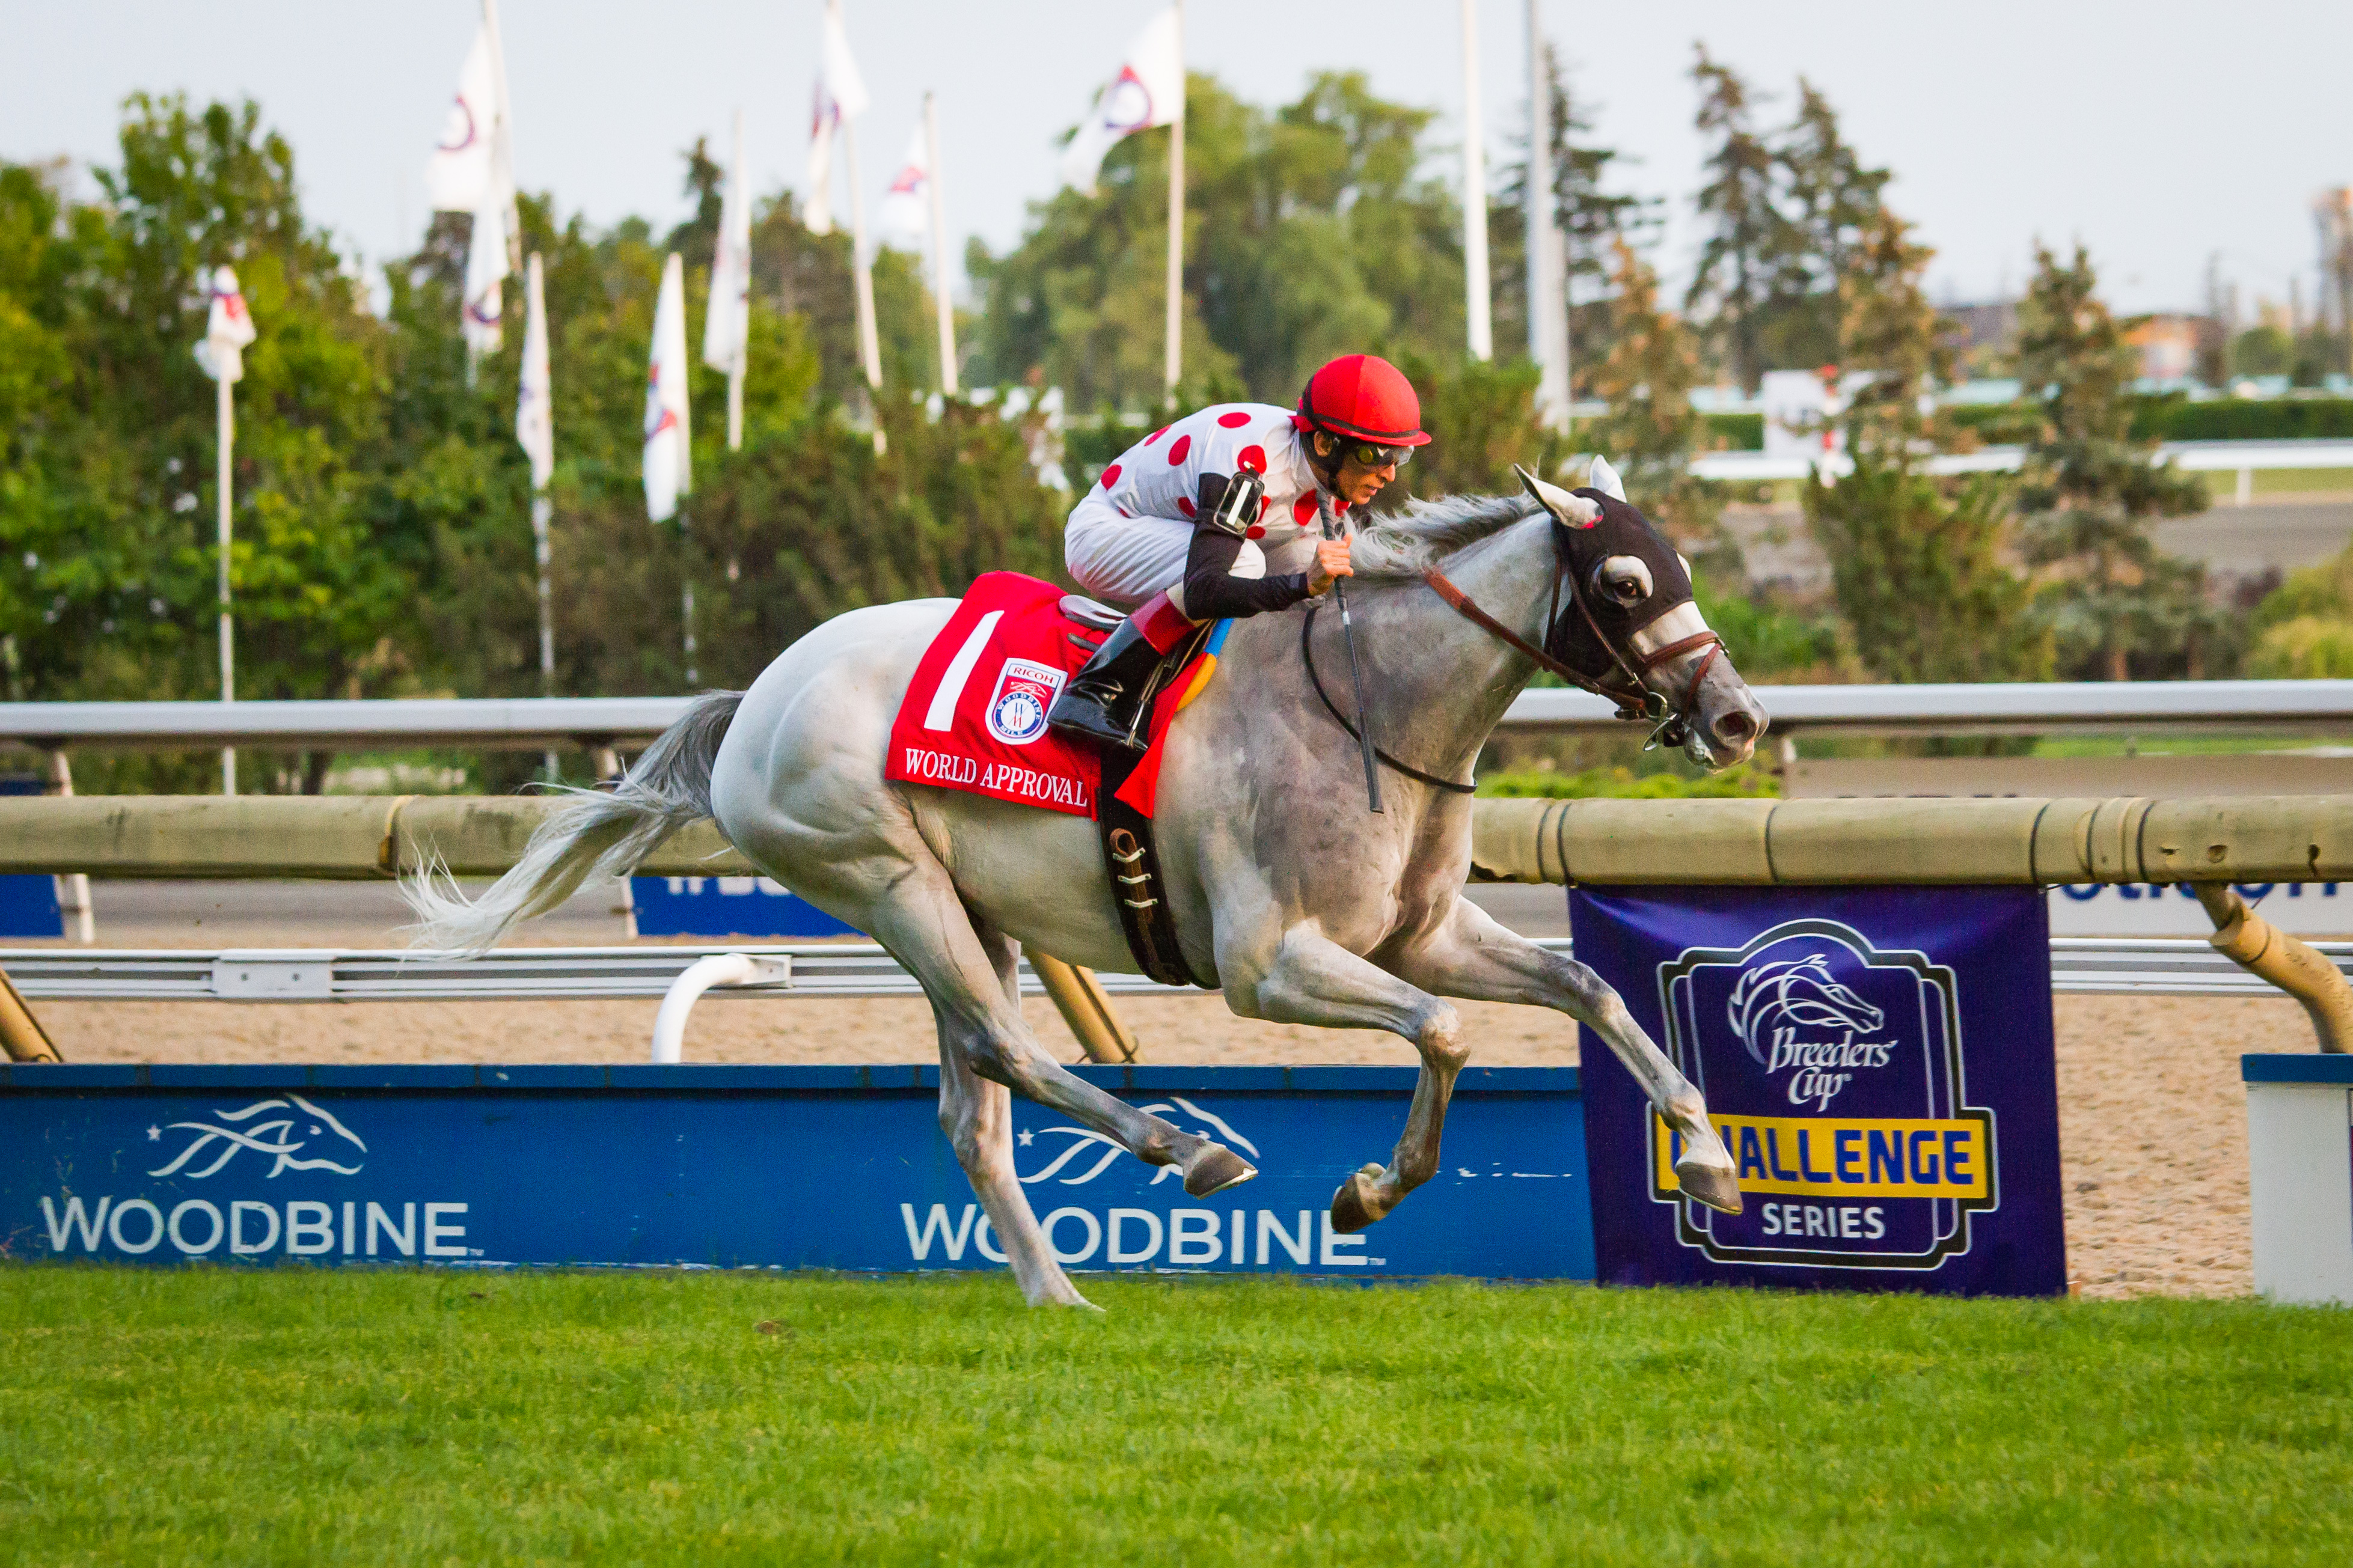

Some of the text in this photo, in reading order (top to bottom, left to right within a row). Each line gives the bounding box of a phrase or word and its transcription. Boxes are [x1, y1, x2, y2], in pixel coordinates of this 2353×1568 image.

[924, 610, 1005, 731] 1
[1014, 667, 1054, 684] RICOH
[997, 693, 1041, 720] WOODBINE
[1000, 726, 1023, 736] MILE
[906, 748, 1088, 807] WORLD APPROVAL
[1788, 1066, 1846, 1112] Cup
[42, 1196, 469, 1257] WOODBINE
[1761, 1203, 1885, 1239] SERIES
